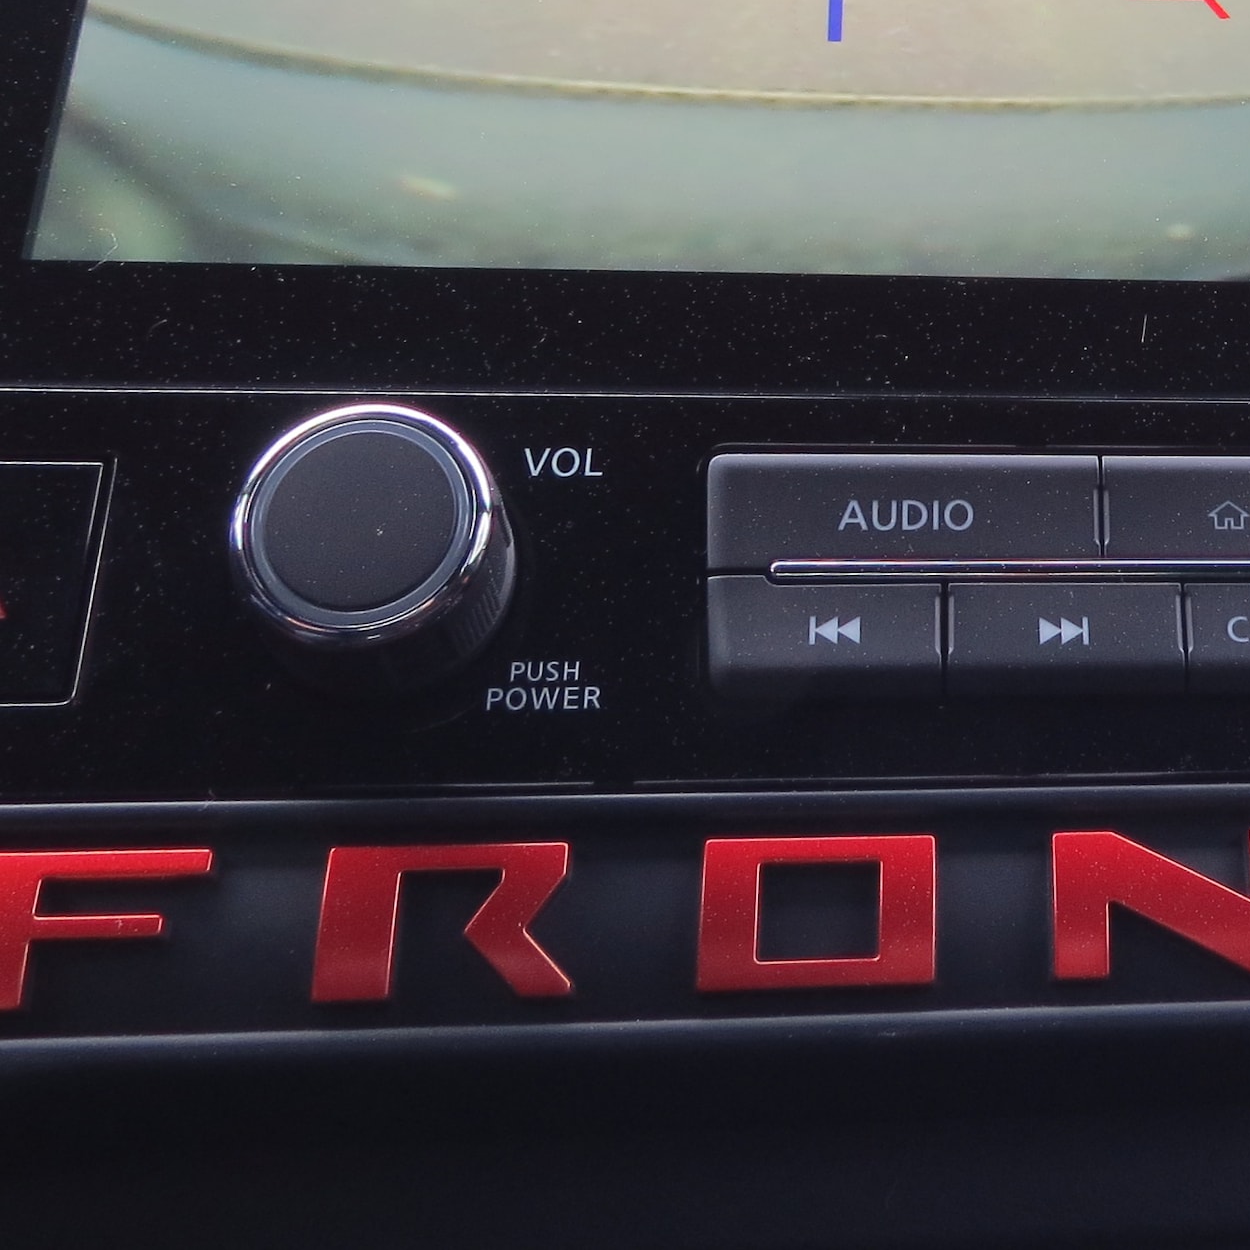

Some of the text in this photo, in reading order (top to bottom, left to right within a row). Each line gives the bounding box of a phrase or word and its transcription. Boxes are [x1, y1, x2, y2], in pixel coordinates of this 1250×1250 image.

[524, 446, 604, 478] VOL
[838, 499, 974, 532] AUDIO
[509, 661, 580, 682] PUSH
[485, 687, 602, 712] POWER
